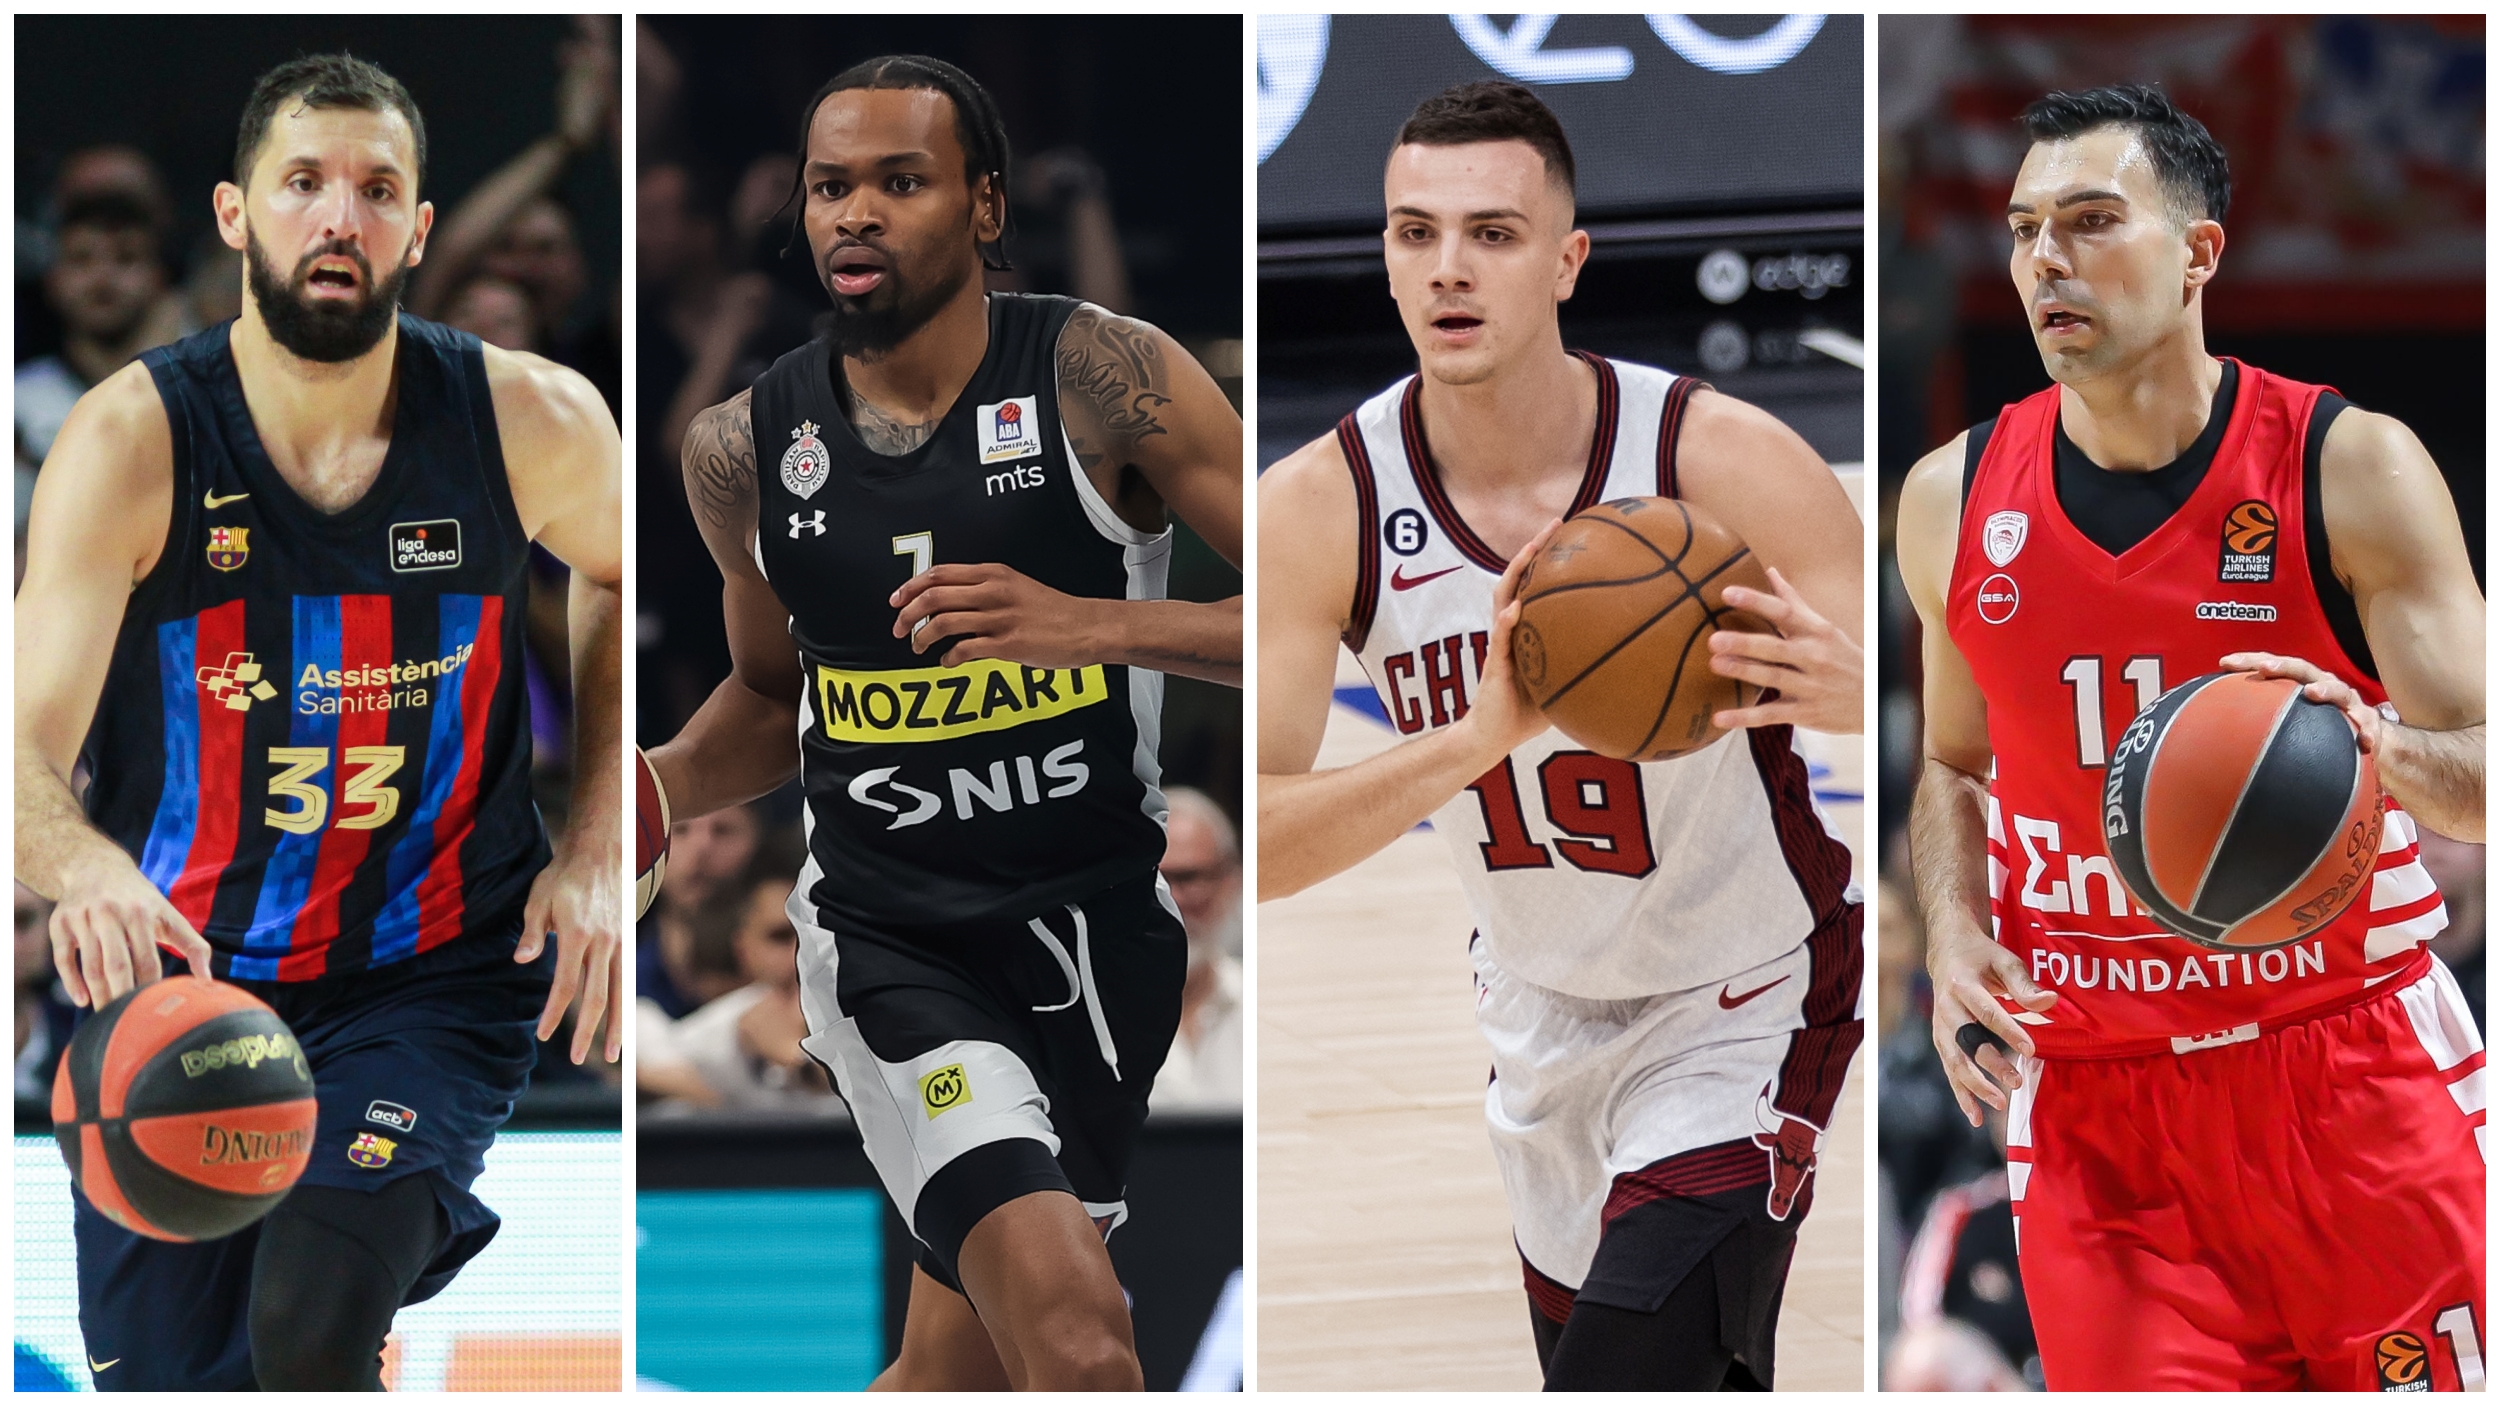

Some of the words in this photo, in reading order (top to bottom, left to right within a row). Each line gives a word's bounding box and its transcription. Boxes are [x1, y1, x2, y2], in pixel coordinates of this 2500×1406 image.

[998, 423, 1020, 440] ABA
[987, 439, 1037, 454] ADMIRAL
[785, 447, 799, 490] PARTIZAN
[986, 464, 1045, 497] mts
[1395, 515, 1419, 550] 6
[397, 538, 424, 553] liga
[398, 549, 456, 565] endesa
[2223, 563, 2270, 572] AIRLINES
[2224, 555, 2270, 564] TURKISH
[2222, 572, 2269, 581] EuroLeague
[1981, 593, 2015, 603] GSA
[2196, 602, 2276, 621] oneteam
[298, 643, 474, 688] Assistència
[299, 684, 428, 715] Sanitària
[2061, 654, 2165, 769] 11
[265, 746, 405, 834] 33
[948, 739, 1089, 820] NIS
[1465, 749, 1658, 880] 19
[2032, 940, 2325, 993] FOUNDATION
[372, 1109, 403, 1125] acb
